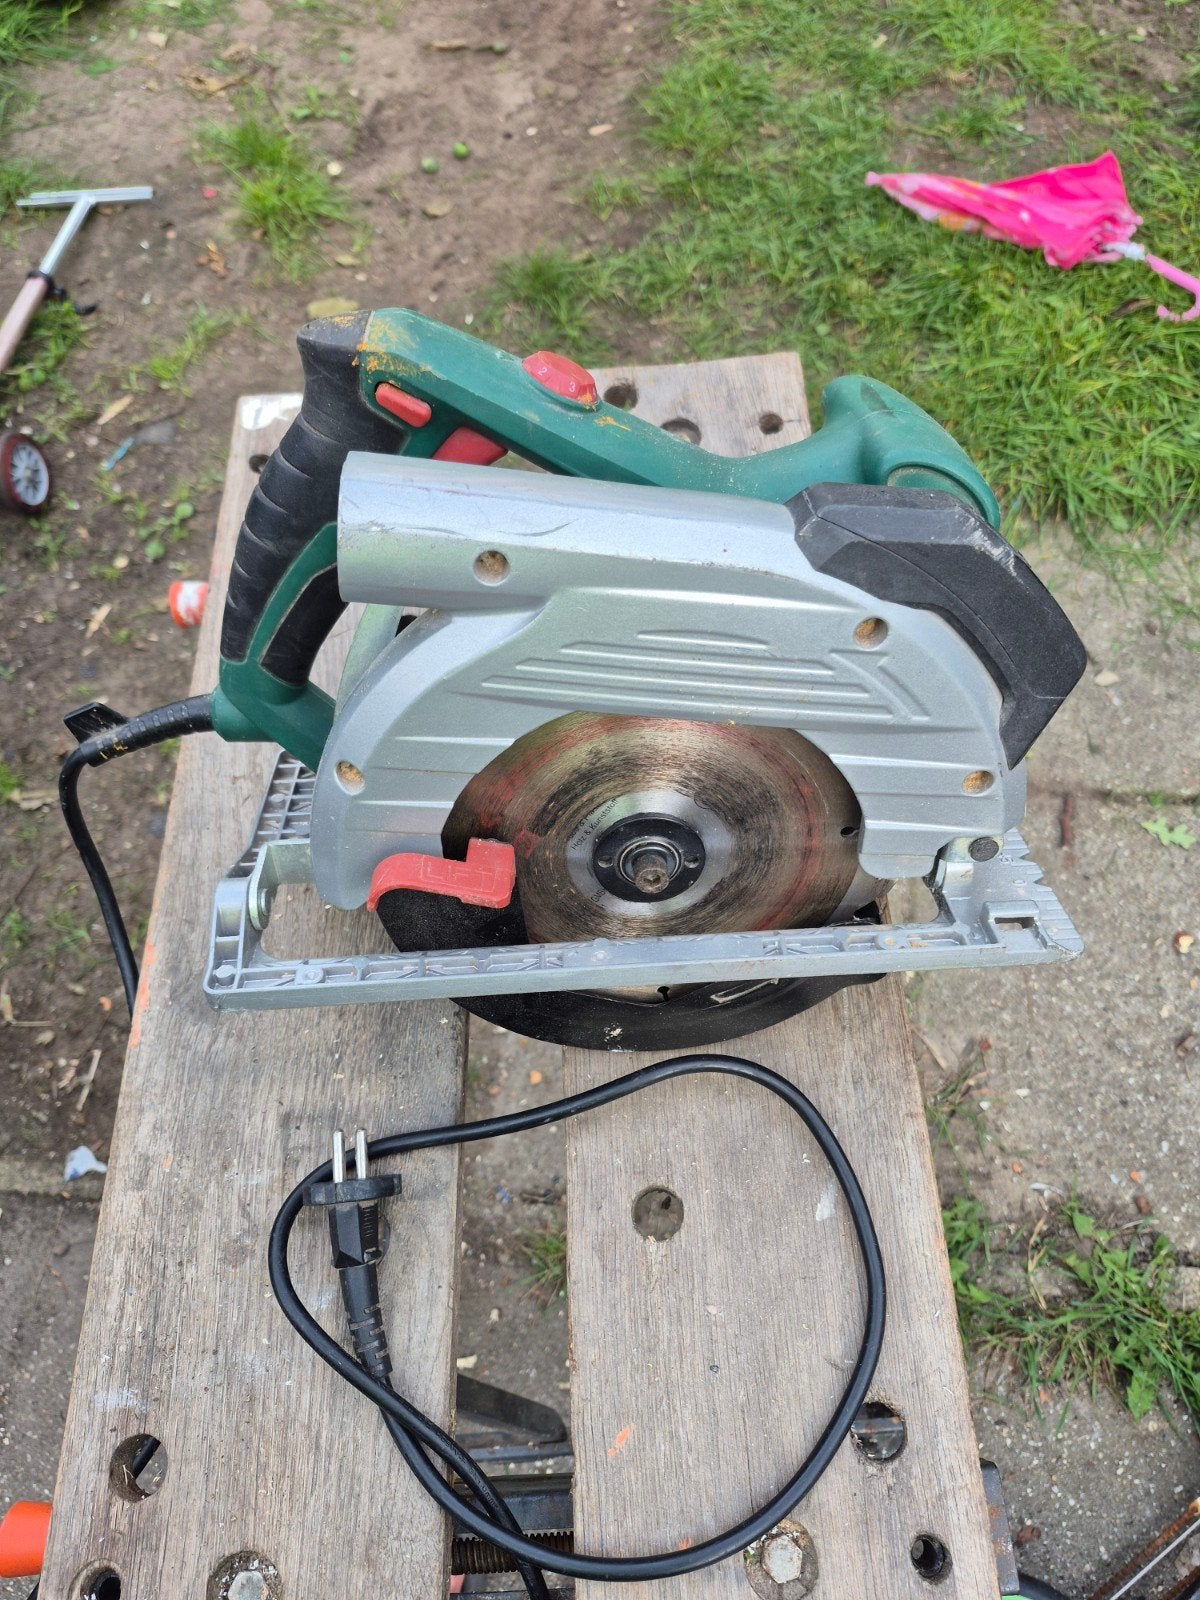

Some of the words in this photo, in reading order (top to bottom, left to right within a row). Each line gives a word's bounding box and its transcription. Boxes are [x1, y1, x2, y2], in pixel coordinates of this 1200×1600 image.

[537, 367, 548, 376] 2
[568, 381, 576, 392] 3
[570, 834, 586, 851] Holz
[583, 828, 592, 837] &
[589, 797, 618, 830] Kunststoff
